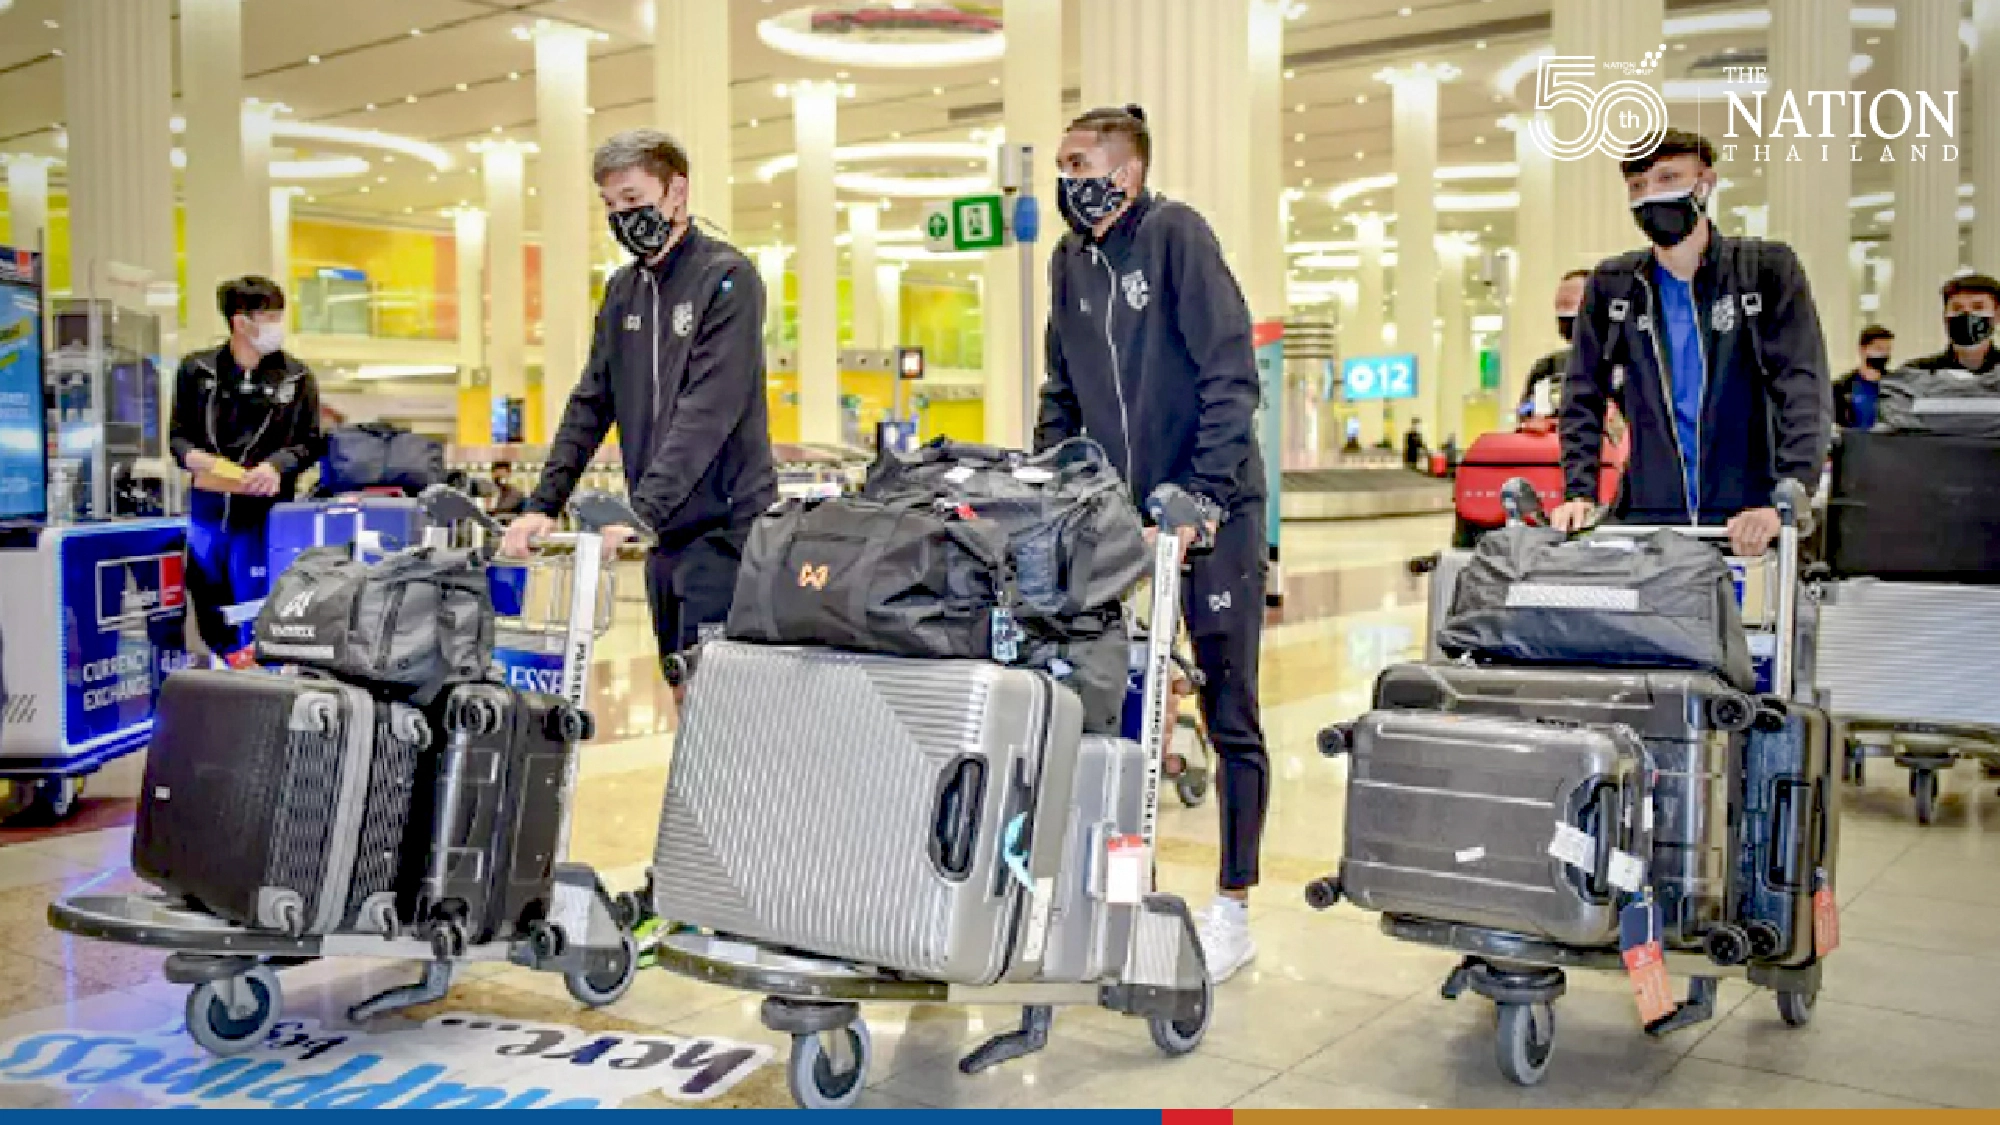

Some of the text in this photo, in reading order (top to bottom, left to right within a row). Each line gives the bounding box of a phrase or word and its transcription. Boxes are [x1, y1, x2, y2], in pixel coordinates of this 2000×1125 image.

[1377, 362, 1409, 394] 12
[83, 650, 151, 683] CURRENCY
[83, 673, 152, 712] EXCHANGE
[1151, 654, 1166, 759] PASSENGER
